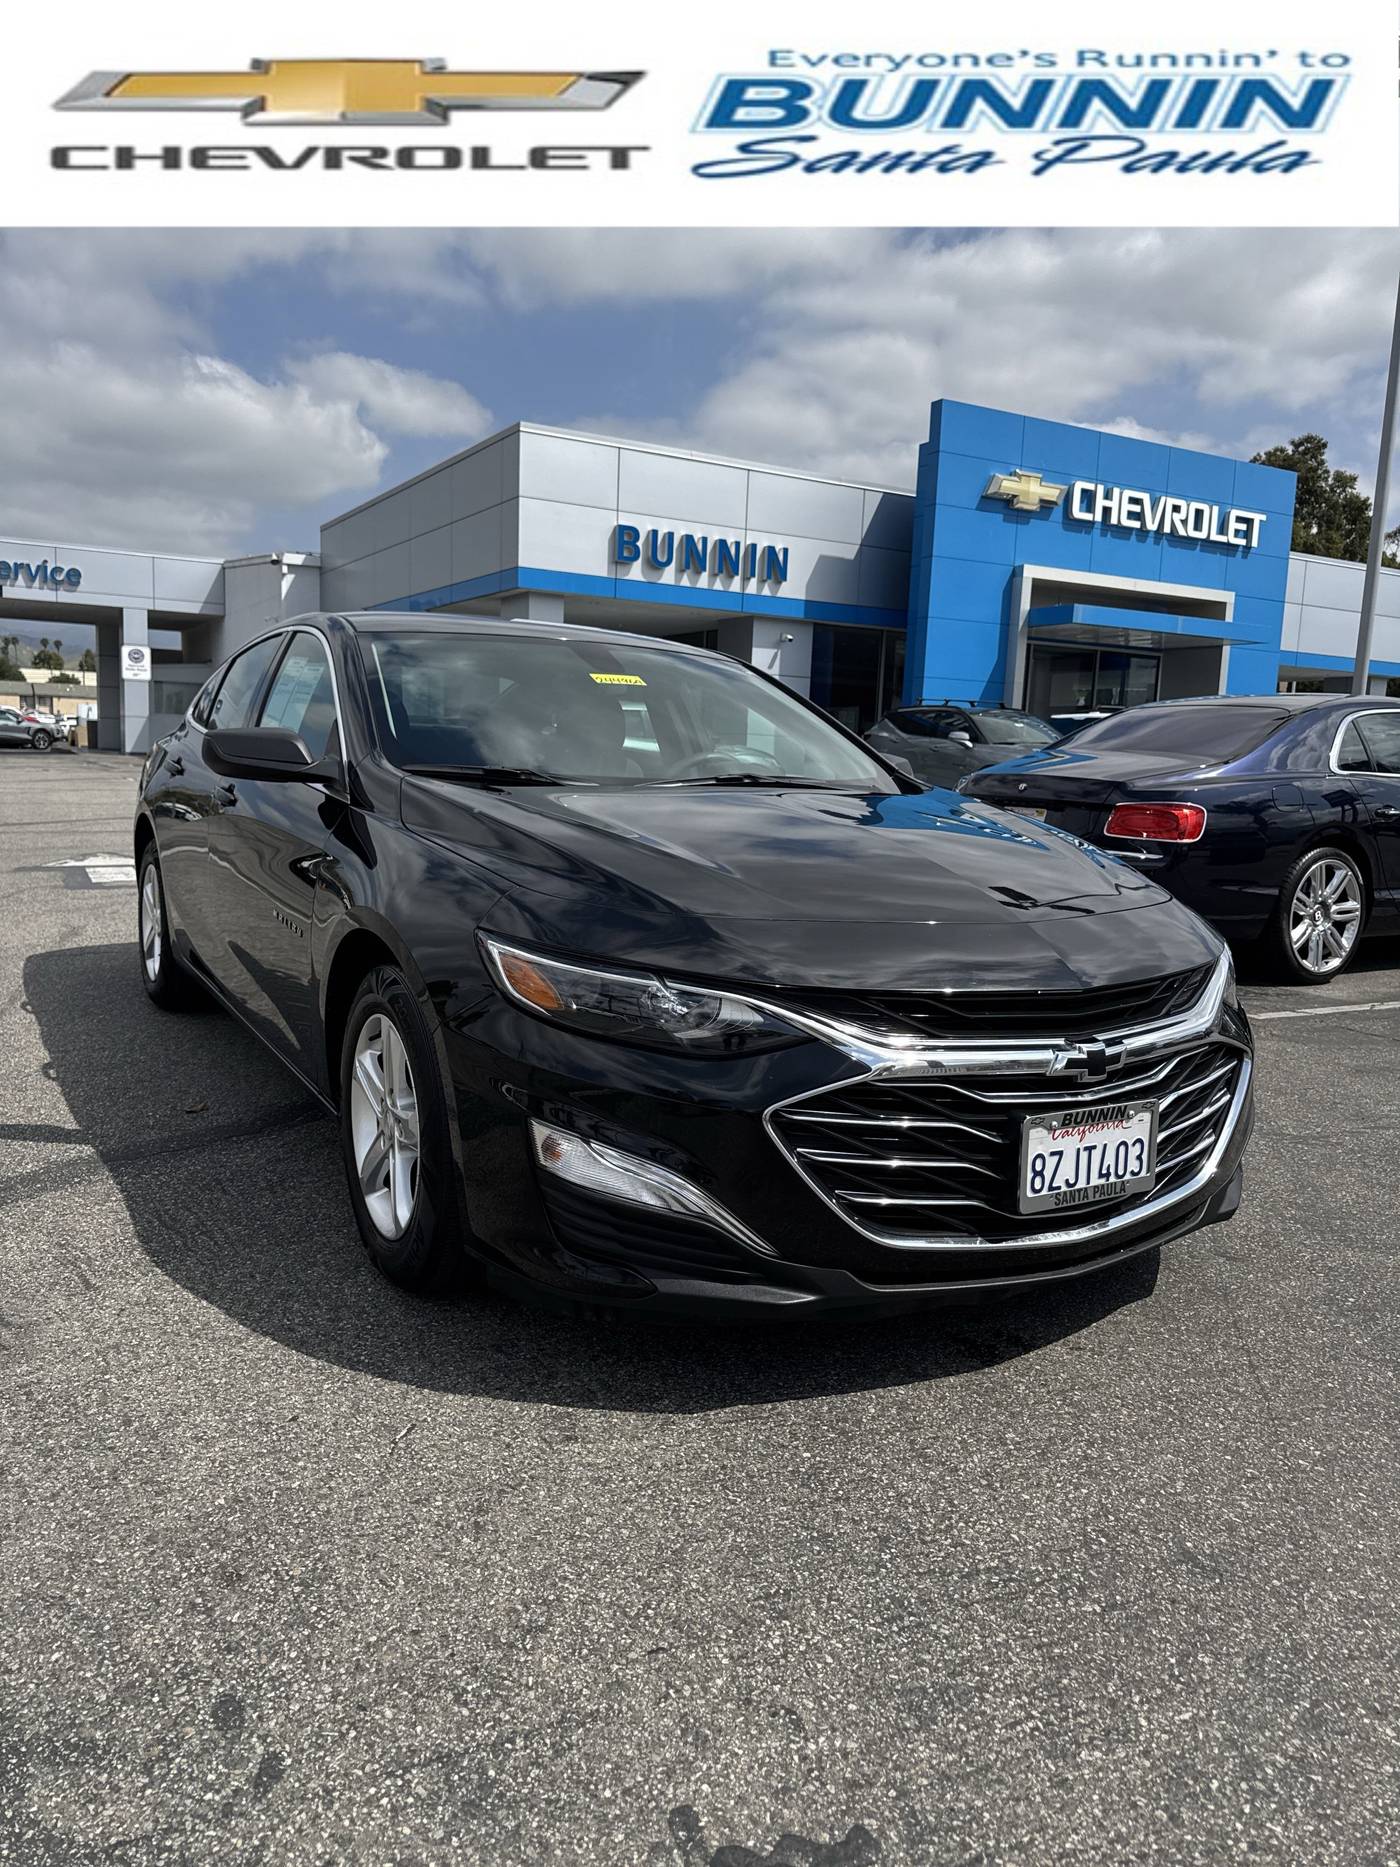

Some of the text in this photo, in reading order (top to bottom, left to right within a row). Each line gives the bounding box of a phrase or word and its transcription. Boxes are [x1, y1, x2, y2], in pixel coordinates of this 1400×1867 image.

[1070, 480, 1267, 548] CHEVROLET
[612, 523, 789, 583] BUNNIN
[1051, 1119, 1133, 1143] California
[1060, 1104, 1129, 1128] BUNNIN
[1030, 1137, 1146, 1195] 8ZJT403
[1053, 1182, 1128, 1207] SANTA PAULA
